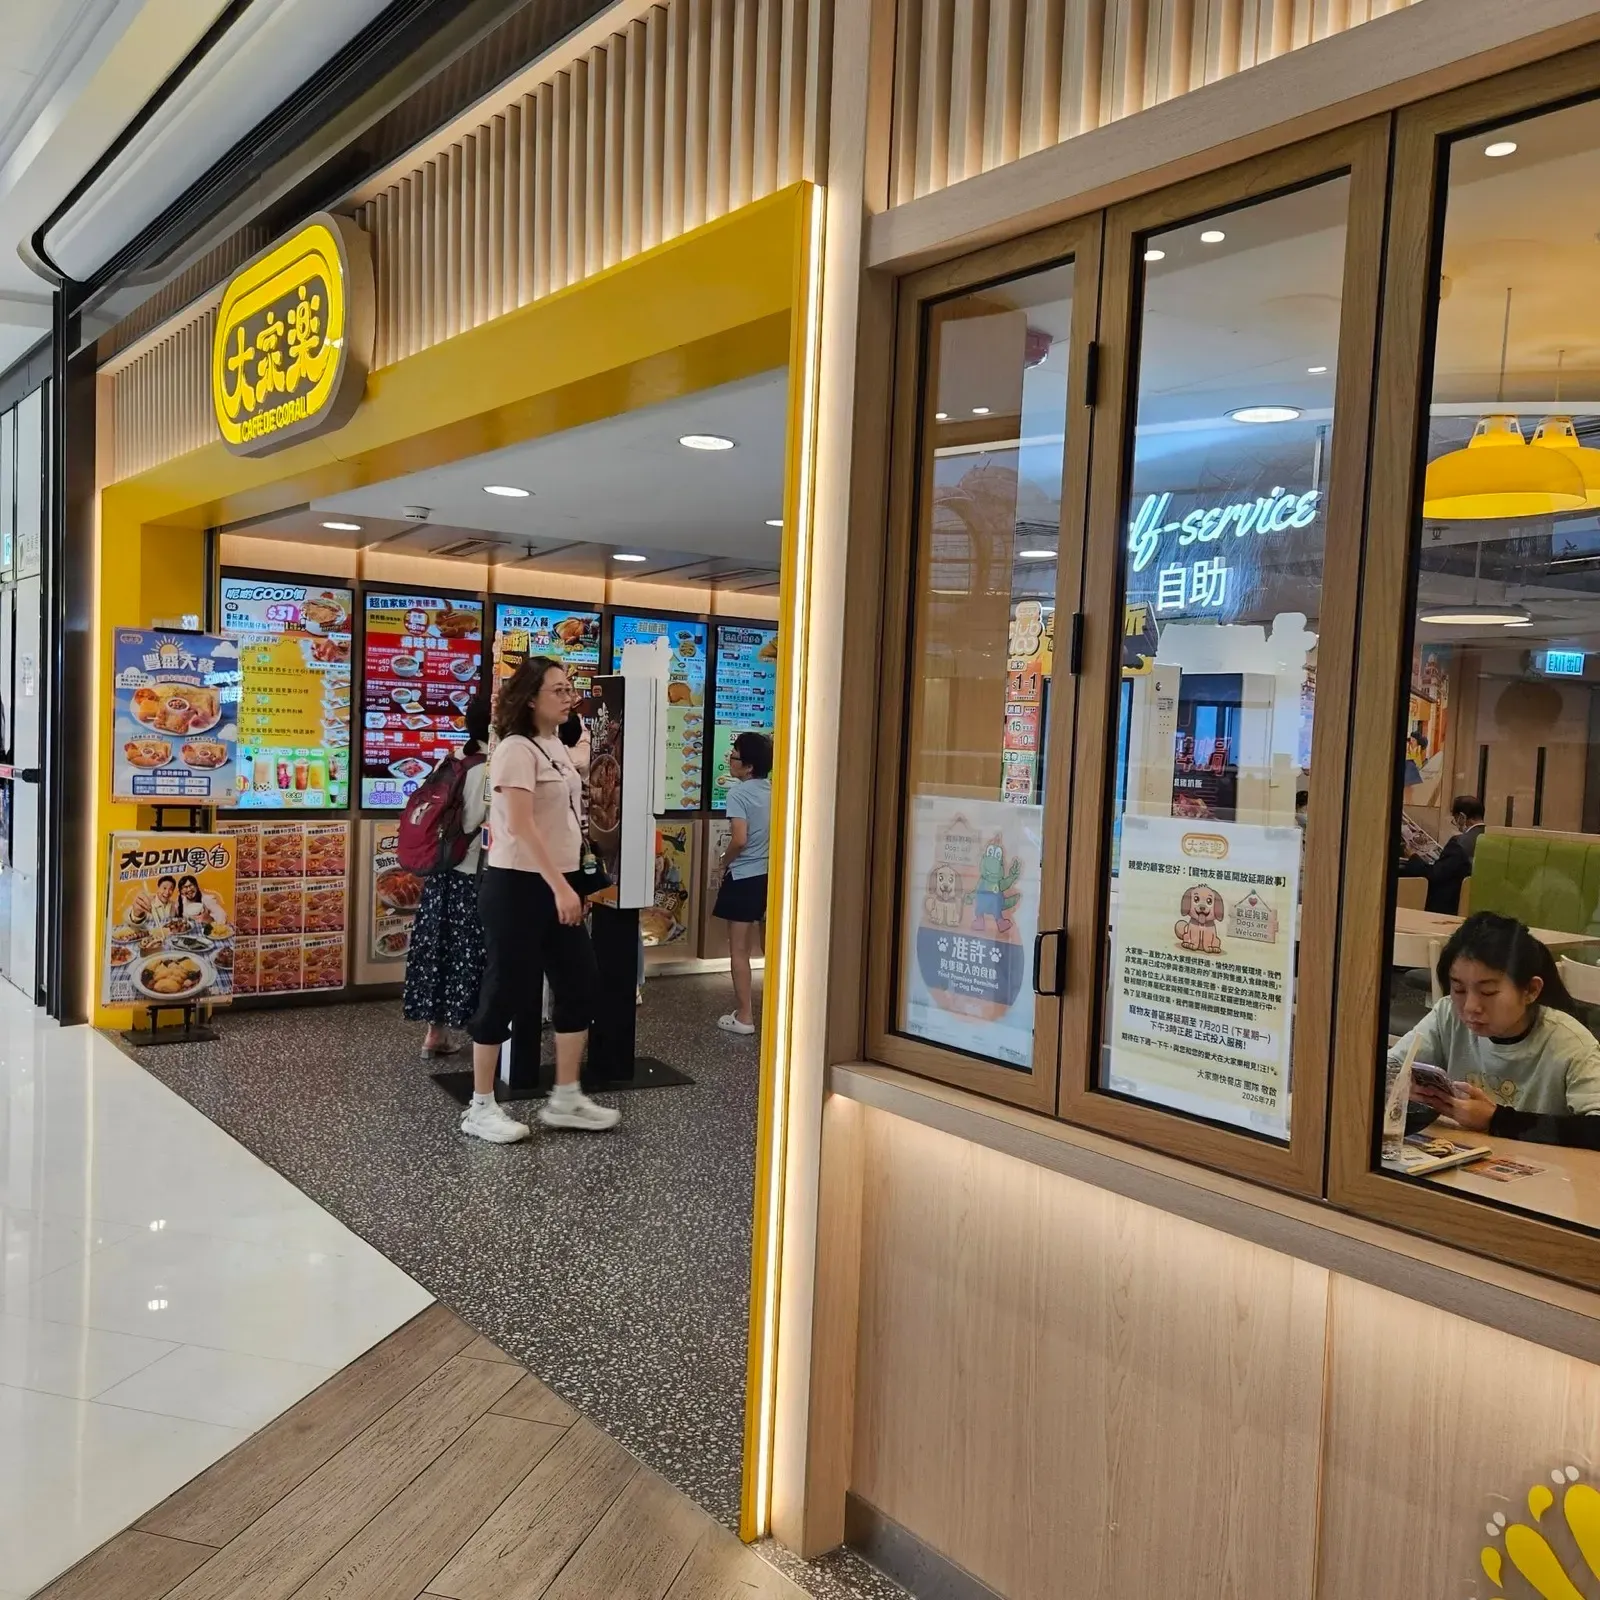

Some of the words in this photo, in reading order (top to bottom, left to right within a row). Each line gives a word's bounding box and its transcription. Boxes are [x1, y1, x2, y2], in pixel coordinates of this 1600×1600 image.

[228, 285, 320, 419] 大家樂
[263, 411, 277, 434] DE
[276, 396, 308, 428] CORAL
[1128, 486, 1320, 572] lf-service
[1157, 556, 1229, 611] 自助
[1549, 654, 1565, 671] EXIT
[1566, 655, 1582, 672] 出口
[1236, 908, 1269, 921] 歡迎狗狗
[1235, 927, 1268, 939] Welcome
[1236, 919, 1255, 930] Dogs
[952, 936, 987, 964] 准許
[951, 973, 973, 983] Premises
[973, 978, 999, 989] Permitted
[959, 983, 969, 991] Dog
[971, 985, 984, 994] Entry
[1150, 1021, 1193, 1038] 下午3時正起
[1197, 1069, 1242, 1089] 大家樂快餐店
[1243, 1080, 1259, 1093] 團隊
[1242, 1092, 1276, 1107] 2026年7月
